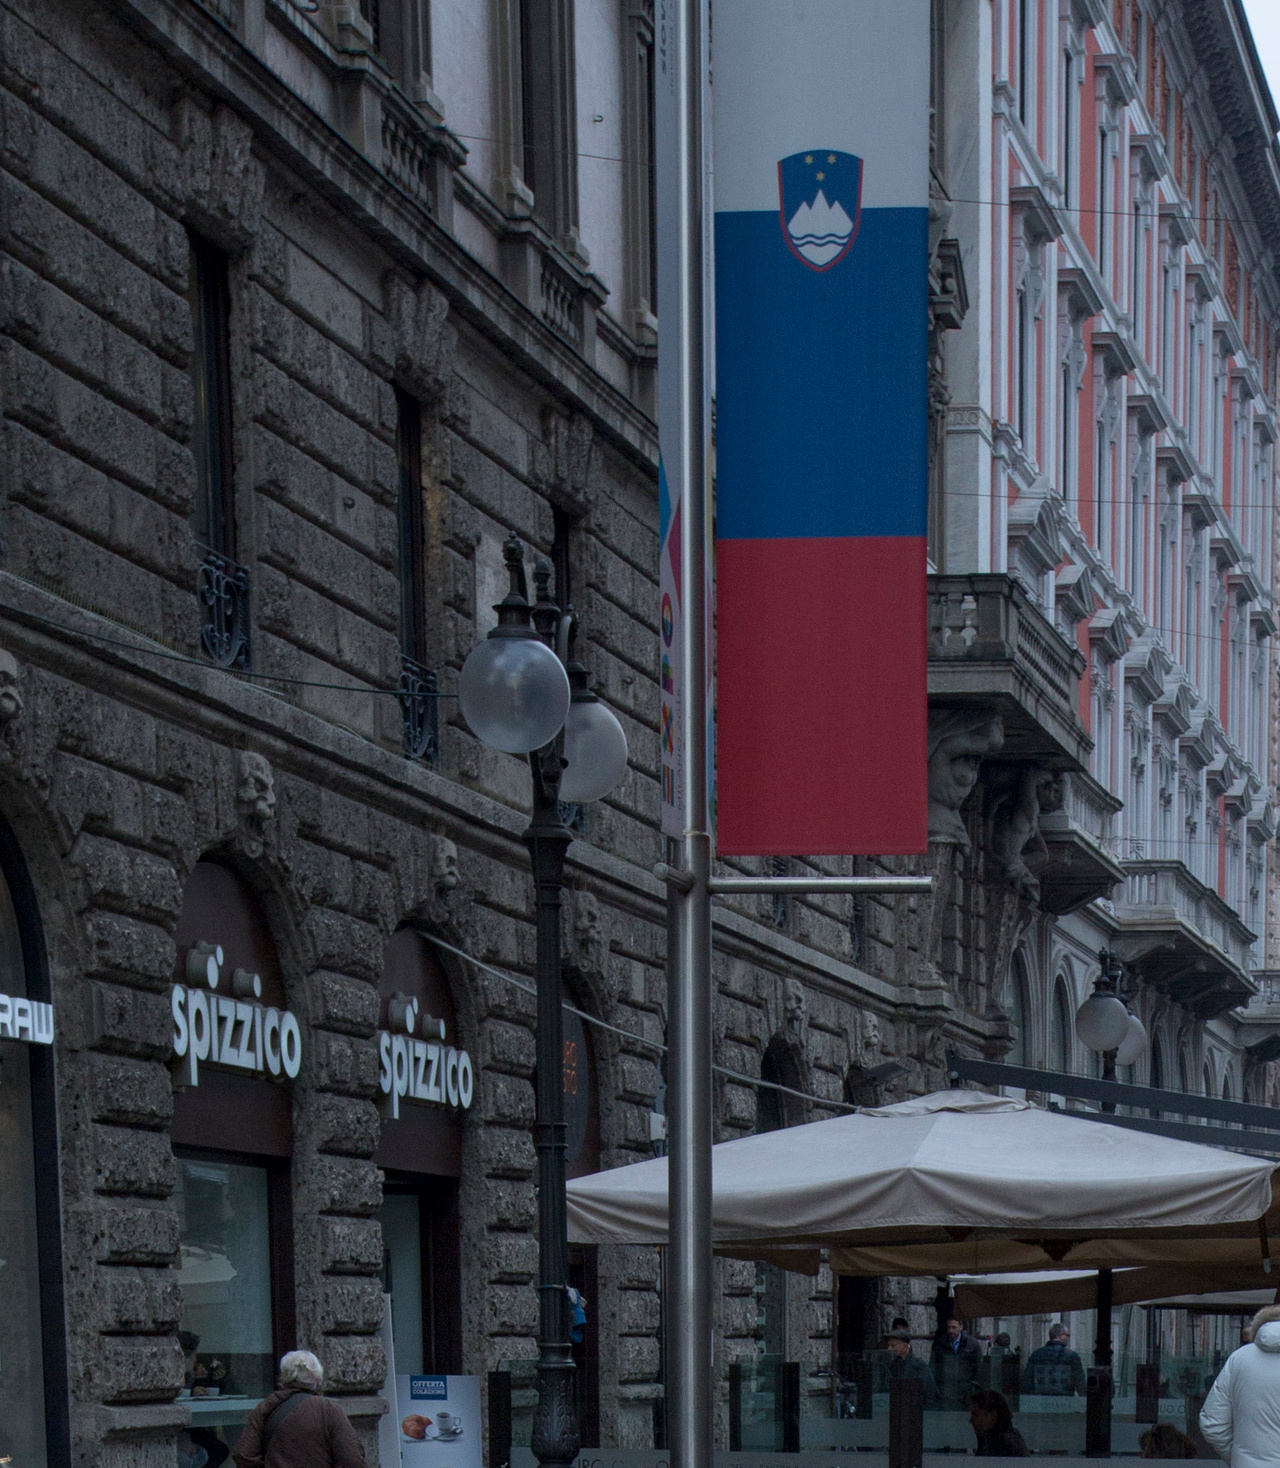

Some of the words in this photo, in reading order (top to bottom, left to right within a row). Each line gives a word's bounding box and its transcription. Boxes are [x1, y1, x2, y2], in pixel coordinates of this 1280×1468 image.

[661, 592, 675, 808] EXPO
[0, 994, 54, 1044] RAW
[172, 983, 301, 1087] spizzico
[380, 1031, 473, 1119] spizzico
[412, 1380, 445, 1388] OFFERTA
